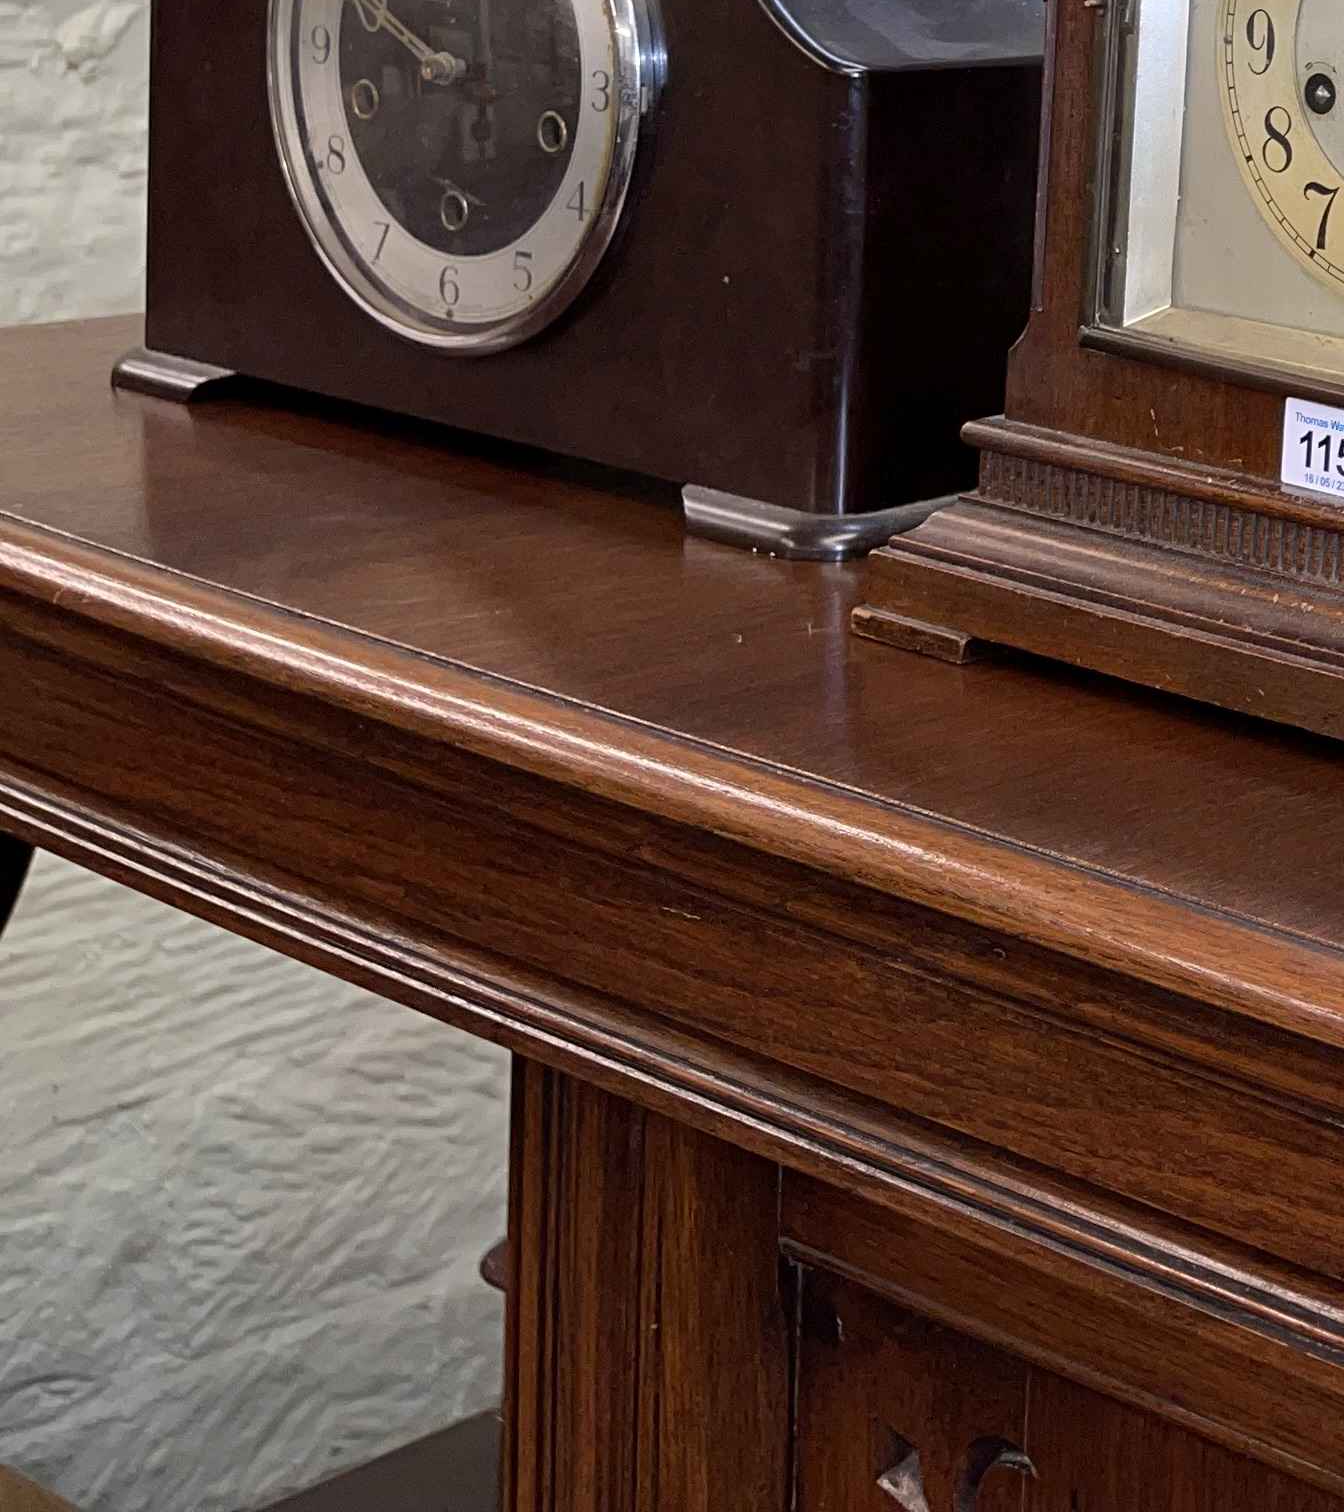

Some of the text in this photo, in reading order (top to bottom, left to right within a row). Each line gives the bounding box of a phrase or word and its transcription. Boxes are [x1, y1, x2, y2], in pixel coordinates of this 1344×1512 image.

[311, 24, 331, 65] 9
[1246, 8, 1276, 76] 9
[591, 70, 610, 112] 3
[327, 135, 346, 175] 8
[1262, 105, 1293, 174] 8
[566, 180, 590, 222] 4
[1303, 181, 1340, 250] 7
[372, 221, 391, 265] 7
[439, 264, 460, 306] 6
[513, 251, 533, 292] 5
[1295, 411, 1329, 429] Thomas
